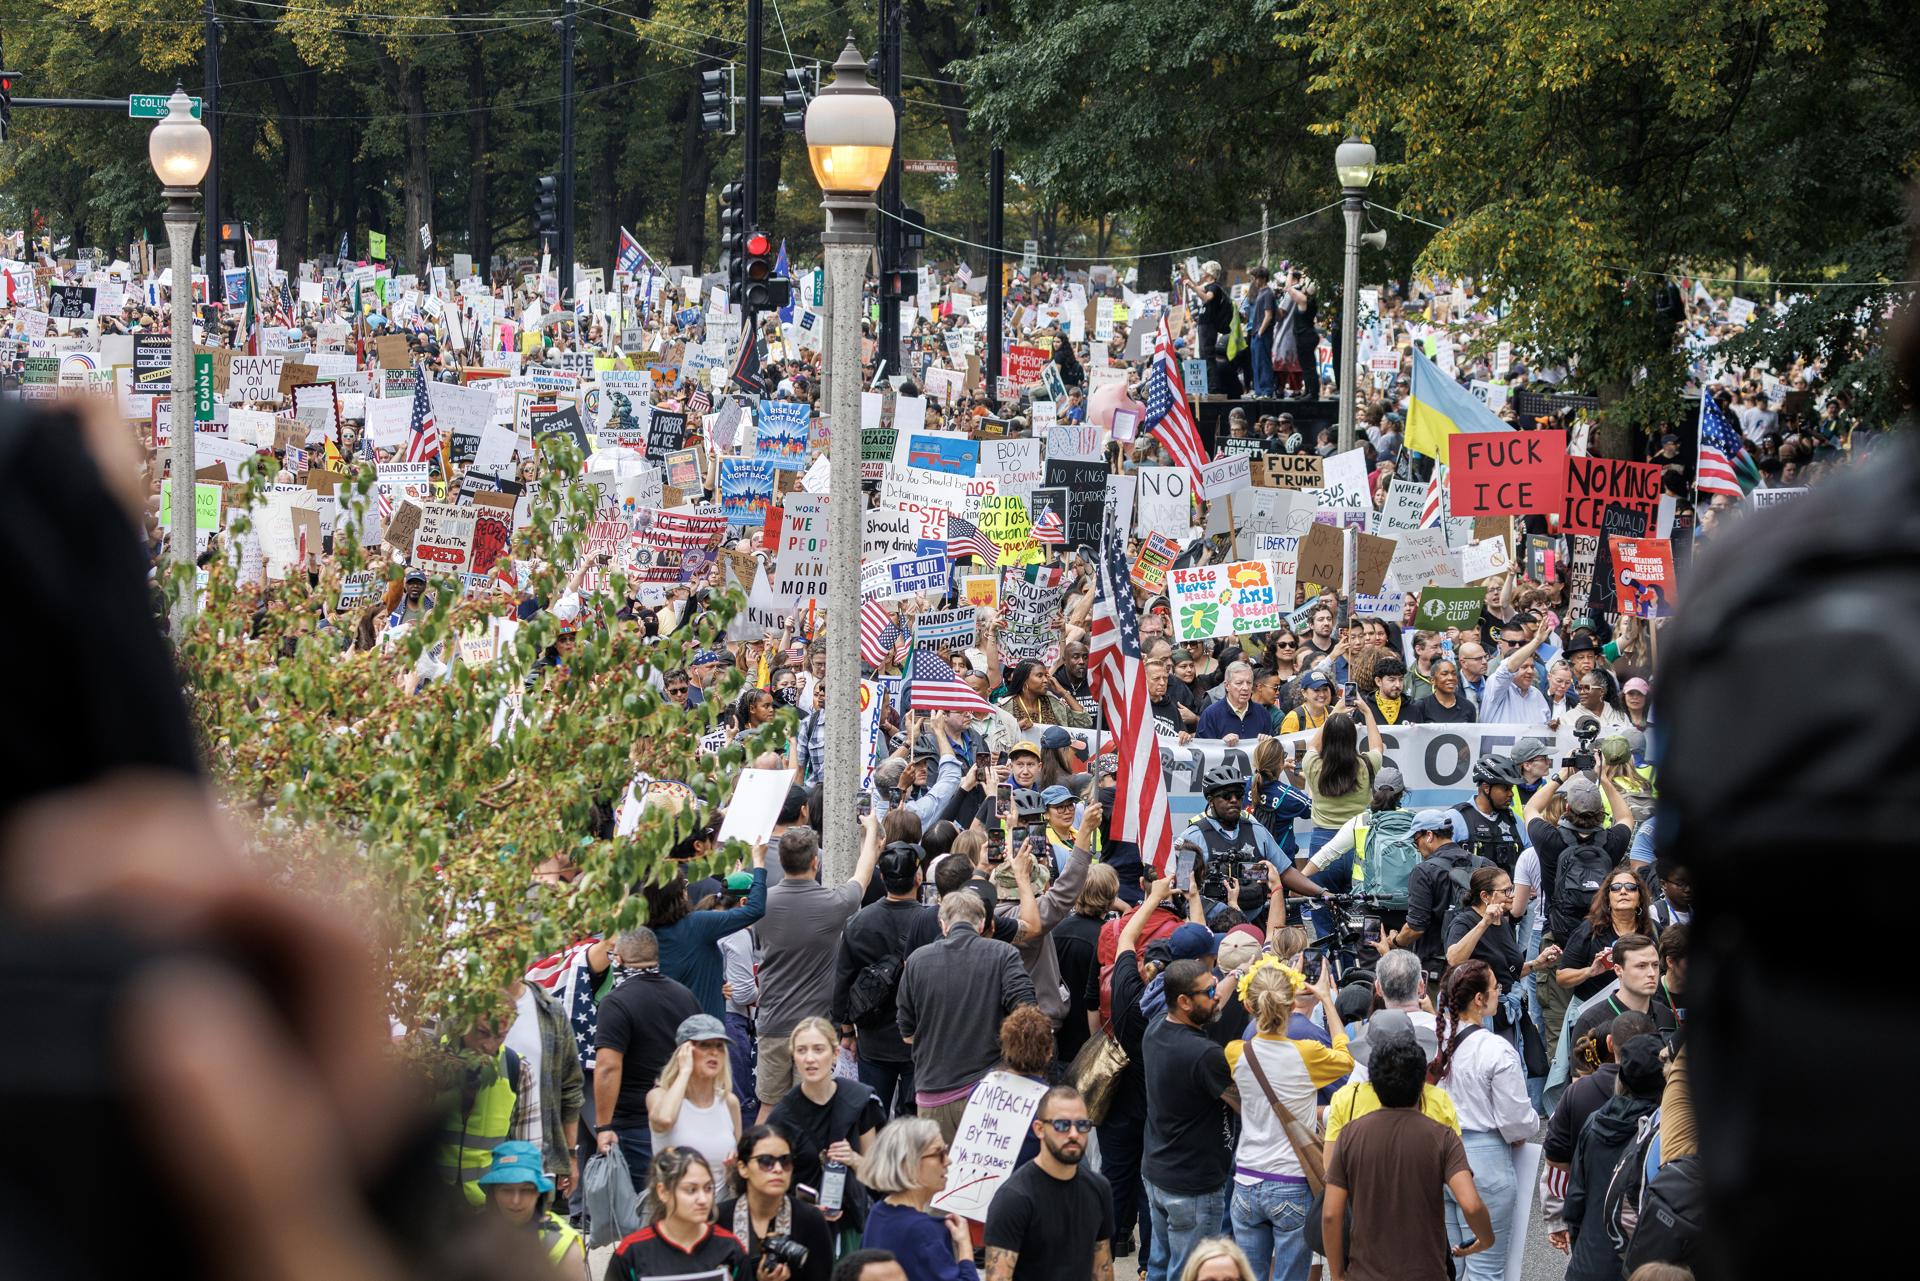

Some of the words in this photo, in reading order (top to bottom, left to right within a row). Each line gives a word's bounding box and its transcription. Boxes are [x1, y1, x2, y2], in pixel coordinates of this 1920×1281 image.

[26, 363, 59, 372] CHICAGO
[232, 358, 282, 376] SHAME
[563, 353, 594, 367] ICE
[24, 376, 57, 384] PALESTINE
[247, 376, 263, 387] ON
[387, 370, 405, 379] STOP
[406, 370, 418, 379] THE
[602, 371, 641, 382] CHICAGO
[200, 363, 210, 412] J230
[240, 387, 274, 401] YOU!
[763, 413, 783, 423] FIGHT
[785, 415, 806, 426] BACK
[770, 407, 789, 415] RISE
[789, 408, 801, 417] UP
[193, 423, 229, 433] GUILTY
[543, 417, 573, 433] GIRL
[650, 433, 661, 444] MY
[663, 435, 675, 448] ICE
[1048, 427, 1096, 456] NO
[1227, 439, 1247, 447] GIVE
[1248, 440, 1260, 448] ME
[997, 441, 1030, 460] BOW
[1217, 445, 1271, 458] LIBERTY
[1467, 439, 1542, 470] FUCK
[378, 464, 408, 473] HANDS
[410, 463, 427, 472] OFF
[734, 464, 752, 472] RISE
[752, 464, 765, 473] UP
[998, 460, 1021, 472] TO
[1268, 456, 1317, 472] FUCK
[727, 471, 747, 480] FIGHT
[749, 472, 771, 482] BACK
[883, 463, 903, 482] Who
[906, 468, 919, 485] You
[922, 472, 952, 489] Should
[1051, 469, 1067, 482] NO
[1075, 469, 1105, 483] KINGS
[1206, 467, 1225, 485] NO
[1271, 473, 1321, 486] TRUMP
[1567, 459, 1606, 497] NO
[465, 480, 495, 492] LIBERTY
[1141, 471, 1185, 499] NO
[1394, 484, 1424, 495] WHEN
[197, 495, 214, 506] NO
[887, 483, 928, 506] Detaining
[1473, 481, 1534, 511] ICE
[1756, 491, 1773, 506] THE
[425, 506, 445, 515] THEY
[446, 507, 460, 517] MAY
[461, 508, 476, 519] RUN
[700, 508, 717, 516] LOVE
[795, 505, 820, 513] WORK
[1562, 497, 1603, 529] ICE
[424, 518, 437, 526] THE
[656, 515, 678, 531] ICE
[866, 517, 910, 534] Should
[1605, 510, 1645, 533] DONALD
[641, 530, 673, 547] MAGA
[1256, 536, 1299, 551] LIBERTY
[1407, 535, 1434, 547] lineage
[863, 540, 872, 553] in
[874, 540, 891, 554] my
[892, 539, 917, 553] drinks
[1422, 546, 1447, 560] 1492
[1619, 547, 1638, 556] STOP
[898, 564, 915, 578] ICE
[917, 559, 938, 575] OUT!
[1139, 561, 1164, 576] ABOLISH
[1174, 568, 1217, 583] Hate
[1634, 564, 1664, 573] DEFEND
[345, 571, 375, 585] HANDS
[927, 574, 945, 588] ICE!
[781, 581, 828, 595] MORO
[1016, 580, 1037, 600] YOU
[1176, 580, 1216, 594] Never
[1184, 590, 1216, 602] Made
[1238, 587, 1273, 605] Any
[1007, 595, 1027, 608] ON
[1028, 595, 1061, 613] SUNDAY
[1230, 602, 1279, 618] Nation
[1448, 600, 1481, 610] SIERRA
[918, 613, 955, 626] HANDS
[956, 609, 975, 622] OFF
[1004, 610, 1025, 623] BUT
[1031, 613, 1048, 625] LET
[1292, 605, 1311, 624] HAND
[1446, 610, 1470, 621] CLUB
[1016, 625, 1039, 635] ICE
[1233, 614, 1280, 632] Great
[918, 633, 974, 652] CHICAGO
[1000, 630, 1031, 645] PREY
[1032, 632, 1052, 645] ALL
[869, 684, 884, 744] SINCE
[1154, 720, 1179, 738] AND
[862, 744, 876, 789] 1776
[970, 1080, 1036, 1117] IMPEACH
[981, 1112, 999, 1131] HIM
[965, 1125, 983, 1143] BY
[987, 1132, 1012, 1150] THE
